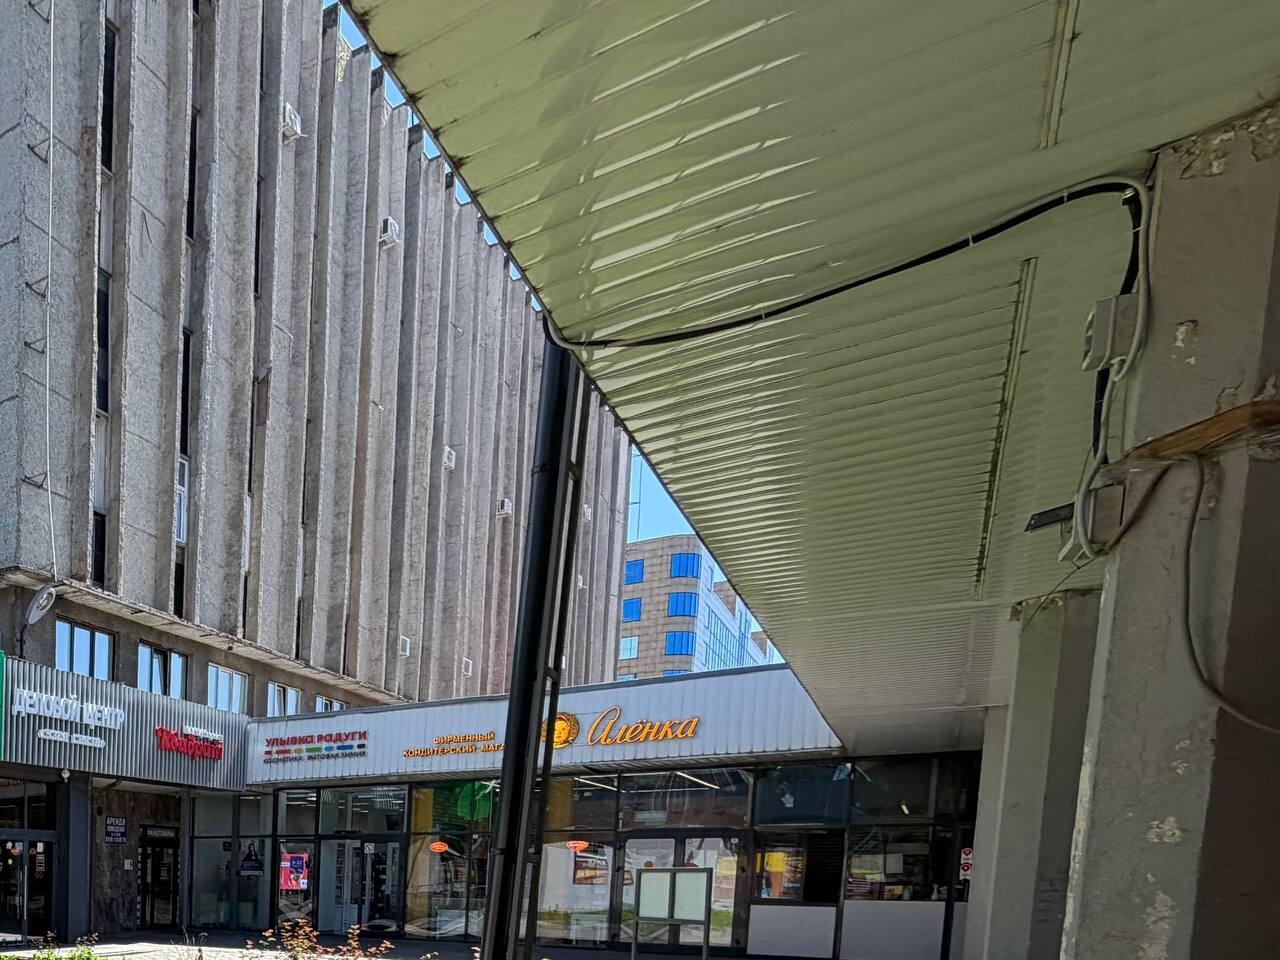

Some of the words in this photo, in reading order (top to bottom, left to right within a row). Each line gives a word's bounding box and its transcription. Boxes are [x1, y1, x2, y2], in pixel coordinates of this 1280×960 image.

[12, 688, 81, 723] ДЕЛОВОЙ
[83, 702, 125, 730] ЦЕНТР
[587, 705, 700, 746] Алёнка
[317, 731, 367, 744] РАДУГИ
[432, 731, 496, 745] ФИРМЕННЫЙ
[402, 744, 476, 757] КОНДИТЕРСКИЙ
